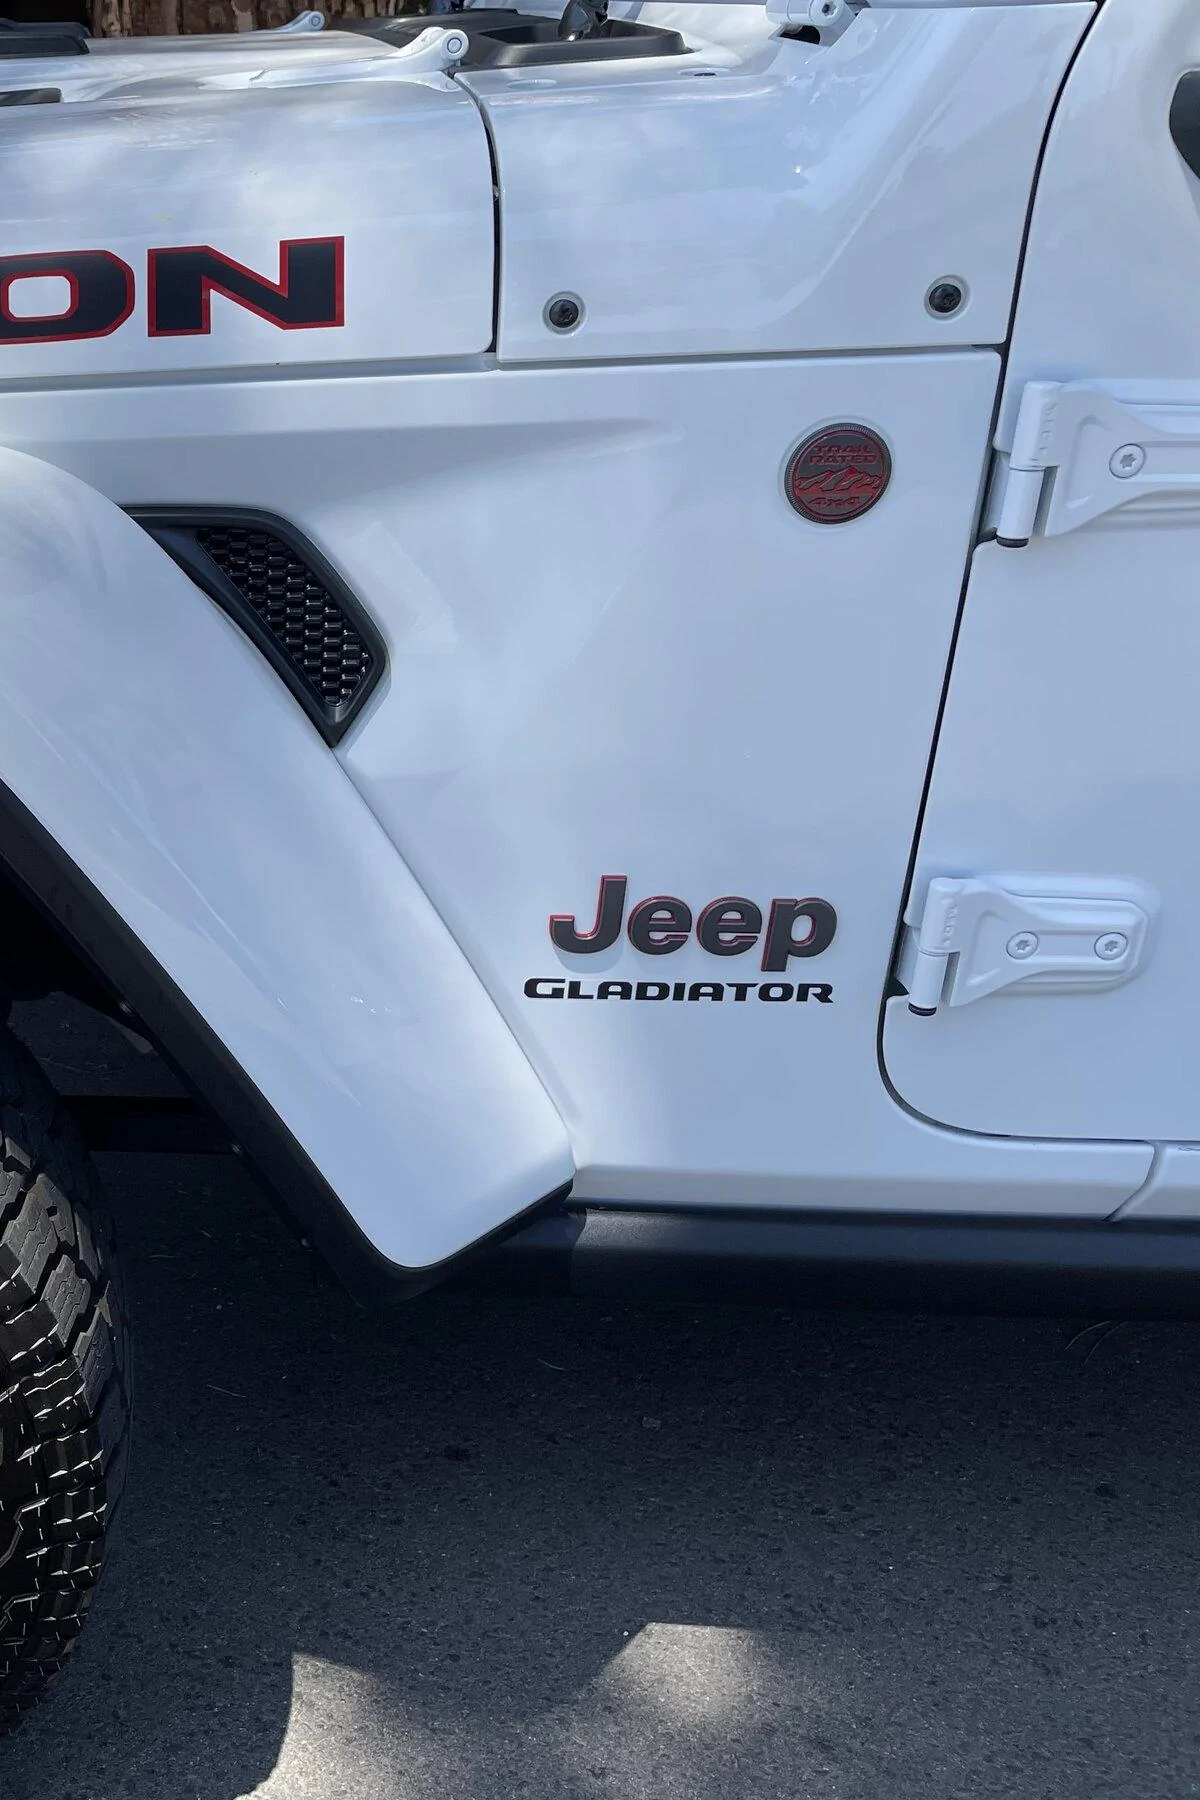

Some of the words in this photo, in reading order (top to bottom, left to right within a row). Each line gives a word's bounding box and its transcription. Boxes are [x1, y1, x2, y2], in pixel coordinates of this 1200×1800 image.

[813, 444, 875, 456] TRAIL
[809, 455, 877, 466] RATED
[548, 874, 838, 972] Jeep
[523, 977, 835, 1004] GLADIATOR
